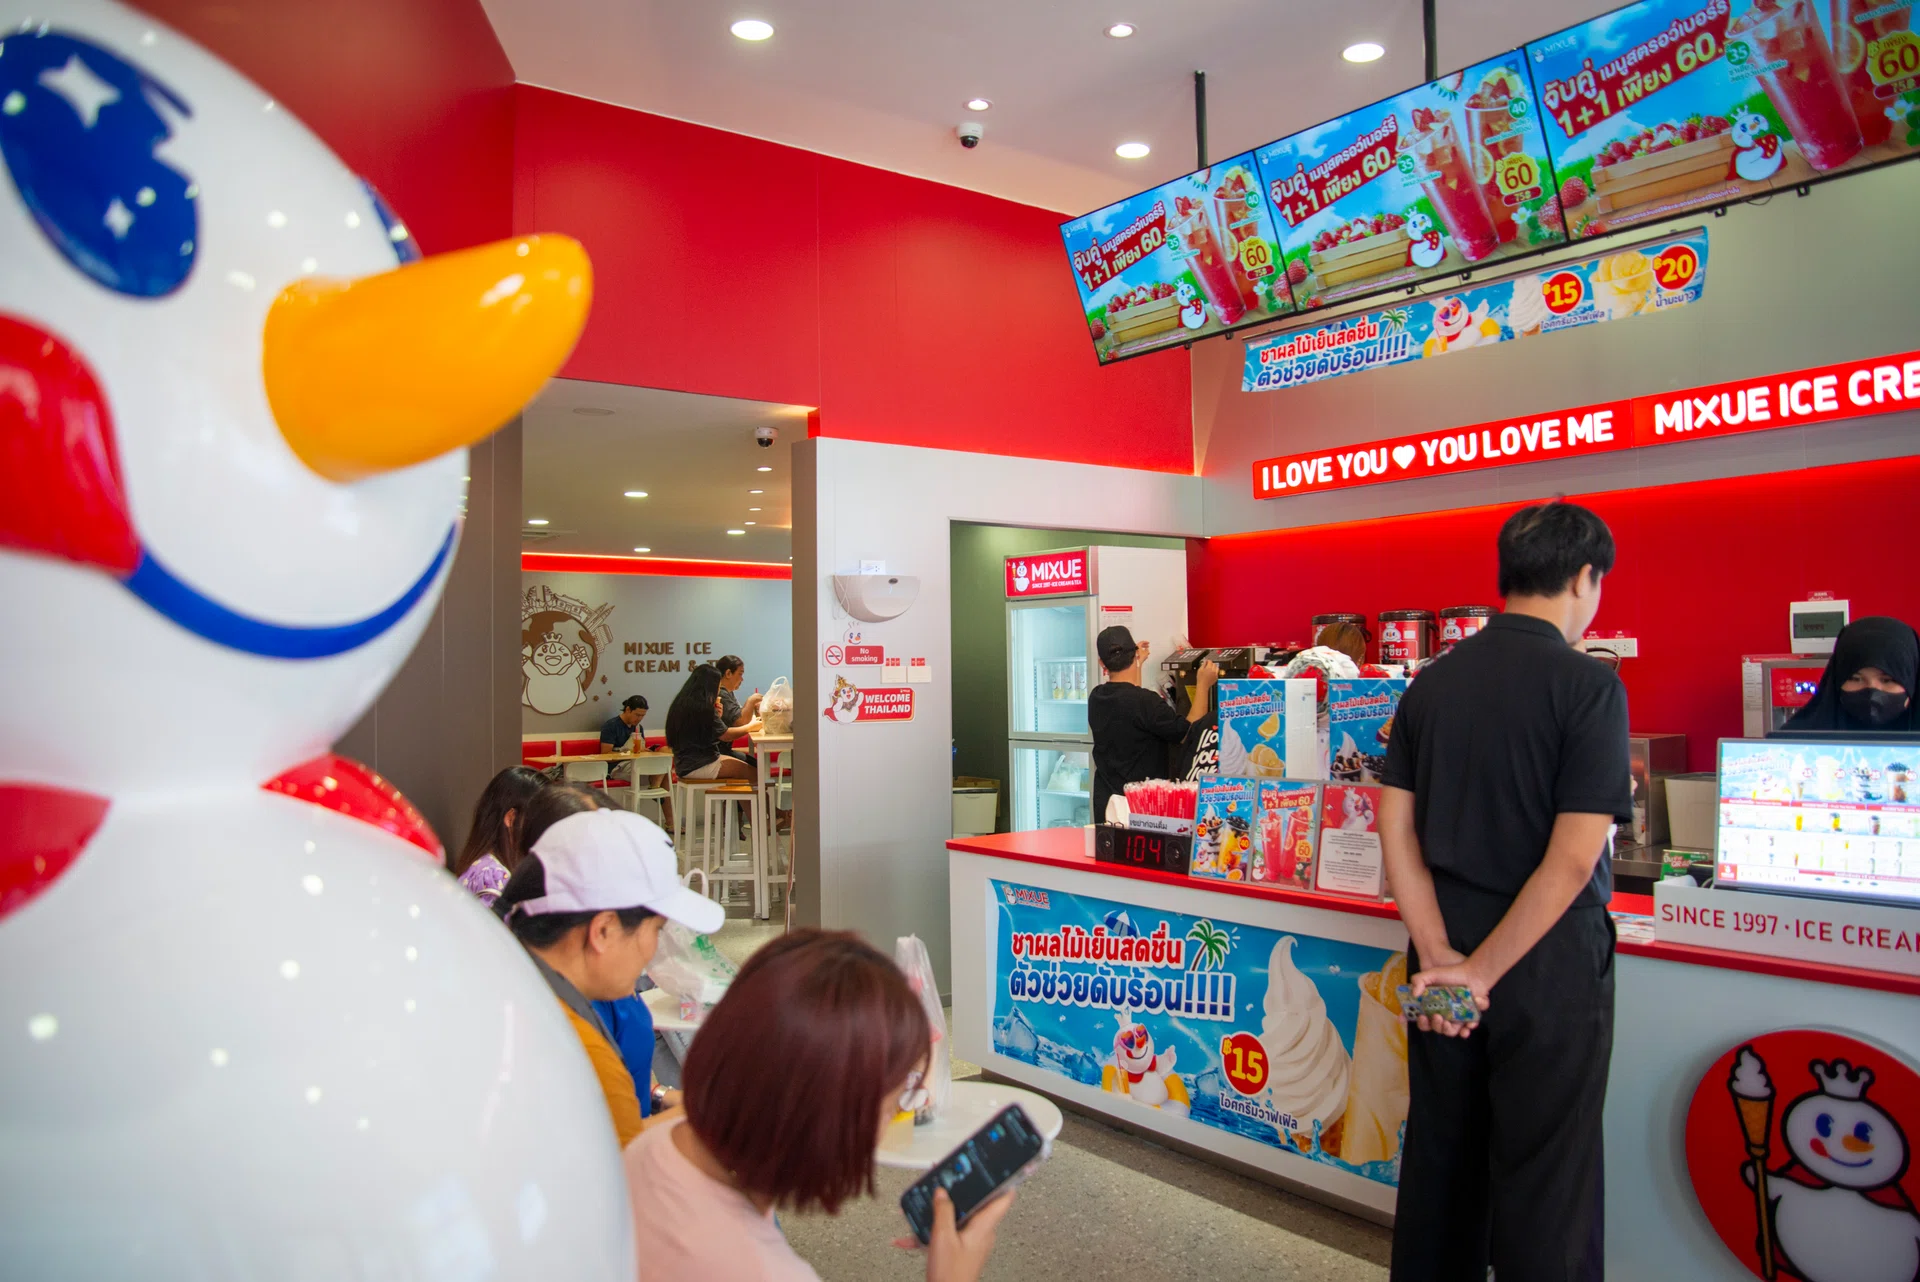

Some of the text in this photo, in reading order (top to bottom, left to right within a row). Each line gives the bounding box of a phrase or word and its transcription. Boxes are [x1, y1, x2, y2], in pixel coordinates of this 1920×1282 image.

[1731, 45, 1749, 62] 35
[1878, 43, 1920, 79] 60
[1558, 89, 1610, 137] 1+1
[1616, 63, 1672, 107] เพียง
[1400, 159, 1413, 170] 35
[1505, 163, 1532, 190] 60
[1282, 188, 1320, 226] 1+1
[1322, 169, 1361, 203] เพียง
[1246, 245, 1267, 267] 60
[1084, 260, 1111, 290] 1+1
[1261, 317, 1377, 364] ชาผลไม้เย็นสดชื่น
[1654, 386, 1770, 435] MIXUE
[1779, 375, 1839, 417] ICE
[1262, 410, 1614, 490] I LOVE YOU YOU LOVE ME
[1031, 558, 1082, 581] MIXUE
[624, 642, 712, 655] MIXUE ICE
[851, 655, 878, 663] smoking
[624, 660, 680, 673] CREAM
[864, 705, 911, 714] THAILAND
[865, 693, 911, 703] WELCOME
[1126, 835, 1161, 863] 104
[1015, 888, 1049, 904] MIXUE
[1661, 903, 1725, 928] SINCE
[1733, 911, 1778, 935] 1997
[1795, 919, 1833, 942] ICE
[1012, 922, 1182, 965] ชาผลไม้เย็นสดชื่น
[1010, 961, 1232, 1017] ตัวช่วยดับร้อน!!!!
